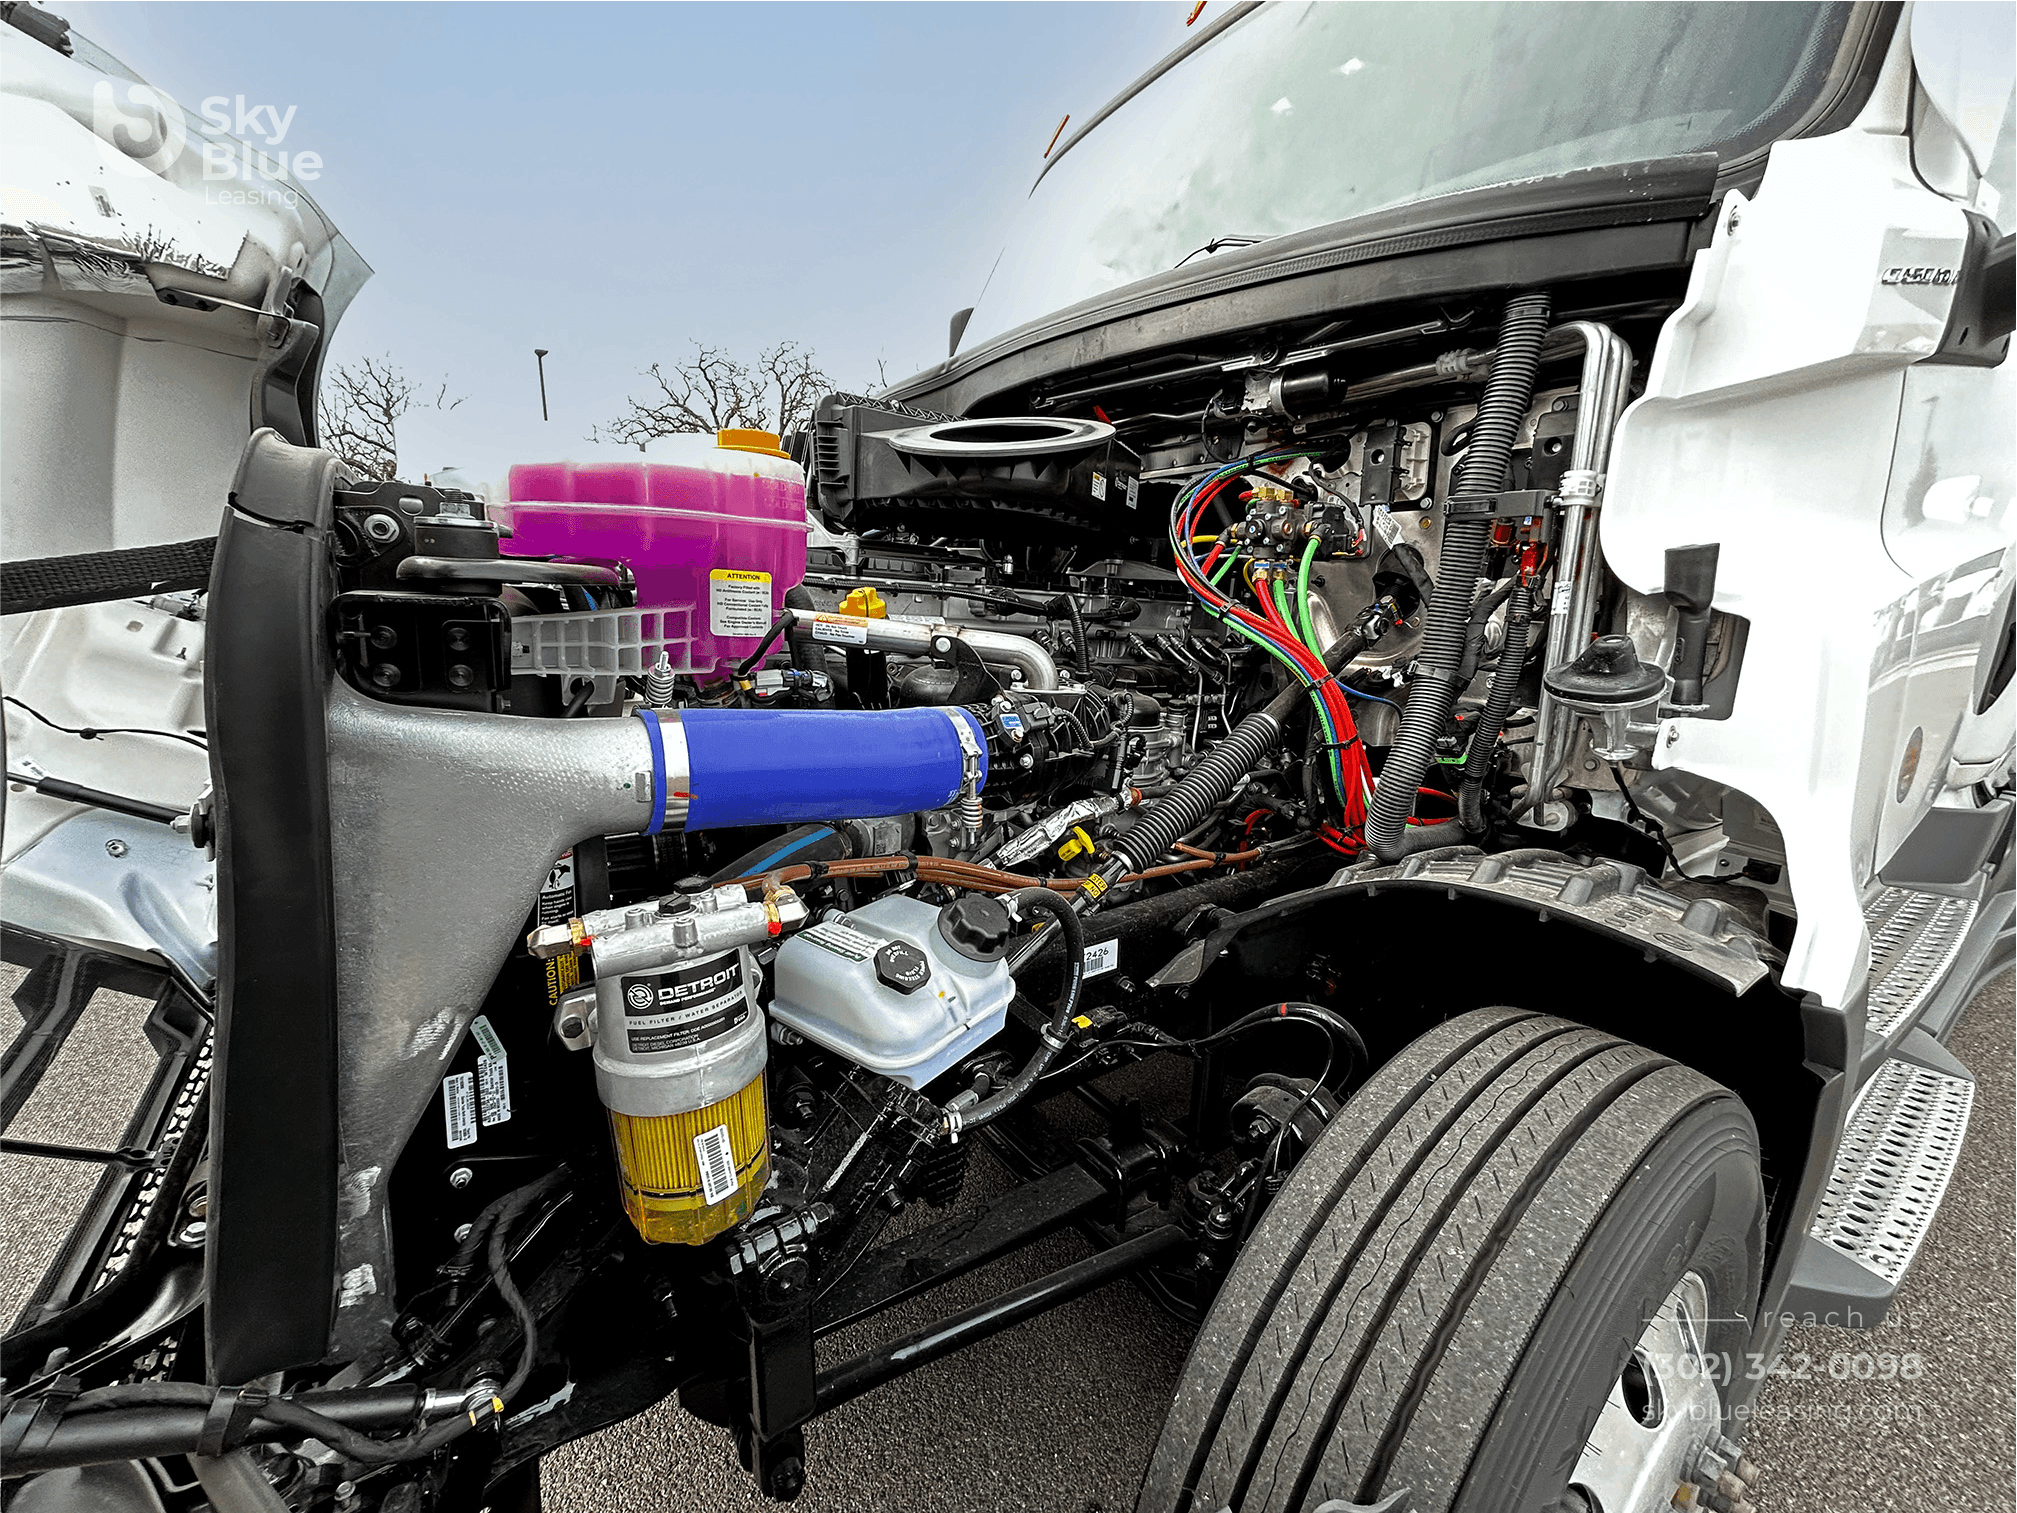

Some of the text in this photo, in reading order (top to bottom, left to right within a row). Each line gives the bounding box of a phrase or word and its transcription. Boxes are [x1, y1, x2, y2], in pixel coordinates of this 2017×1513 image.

[726, 572, 760, 580] ATTENTION
[1092, 876, 1107, 889] STEP
[1084, 947, 1109, 960] 2426
[546, 958, 558, 1006] CAUTION:
[658, 963, 739, 1000] DETROIT
[650, 1016, 675, 1025] FILTER
[685, 1007, 709, 1018] WATER
[712, 990, 743, 1010] SEPARATOR
